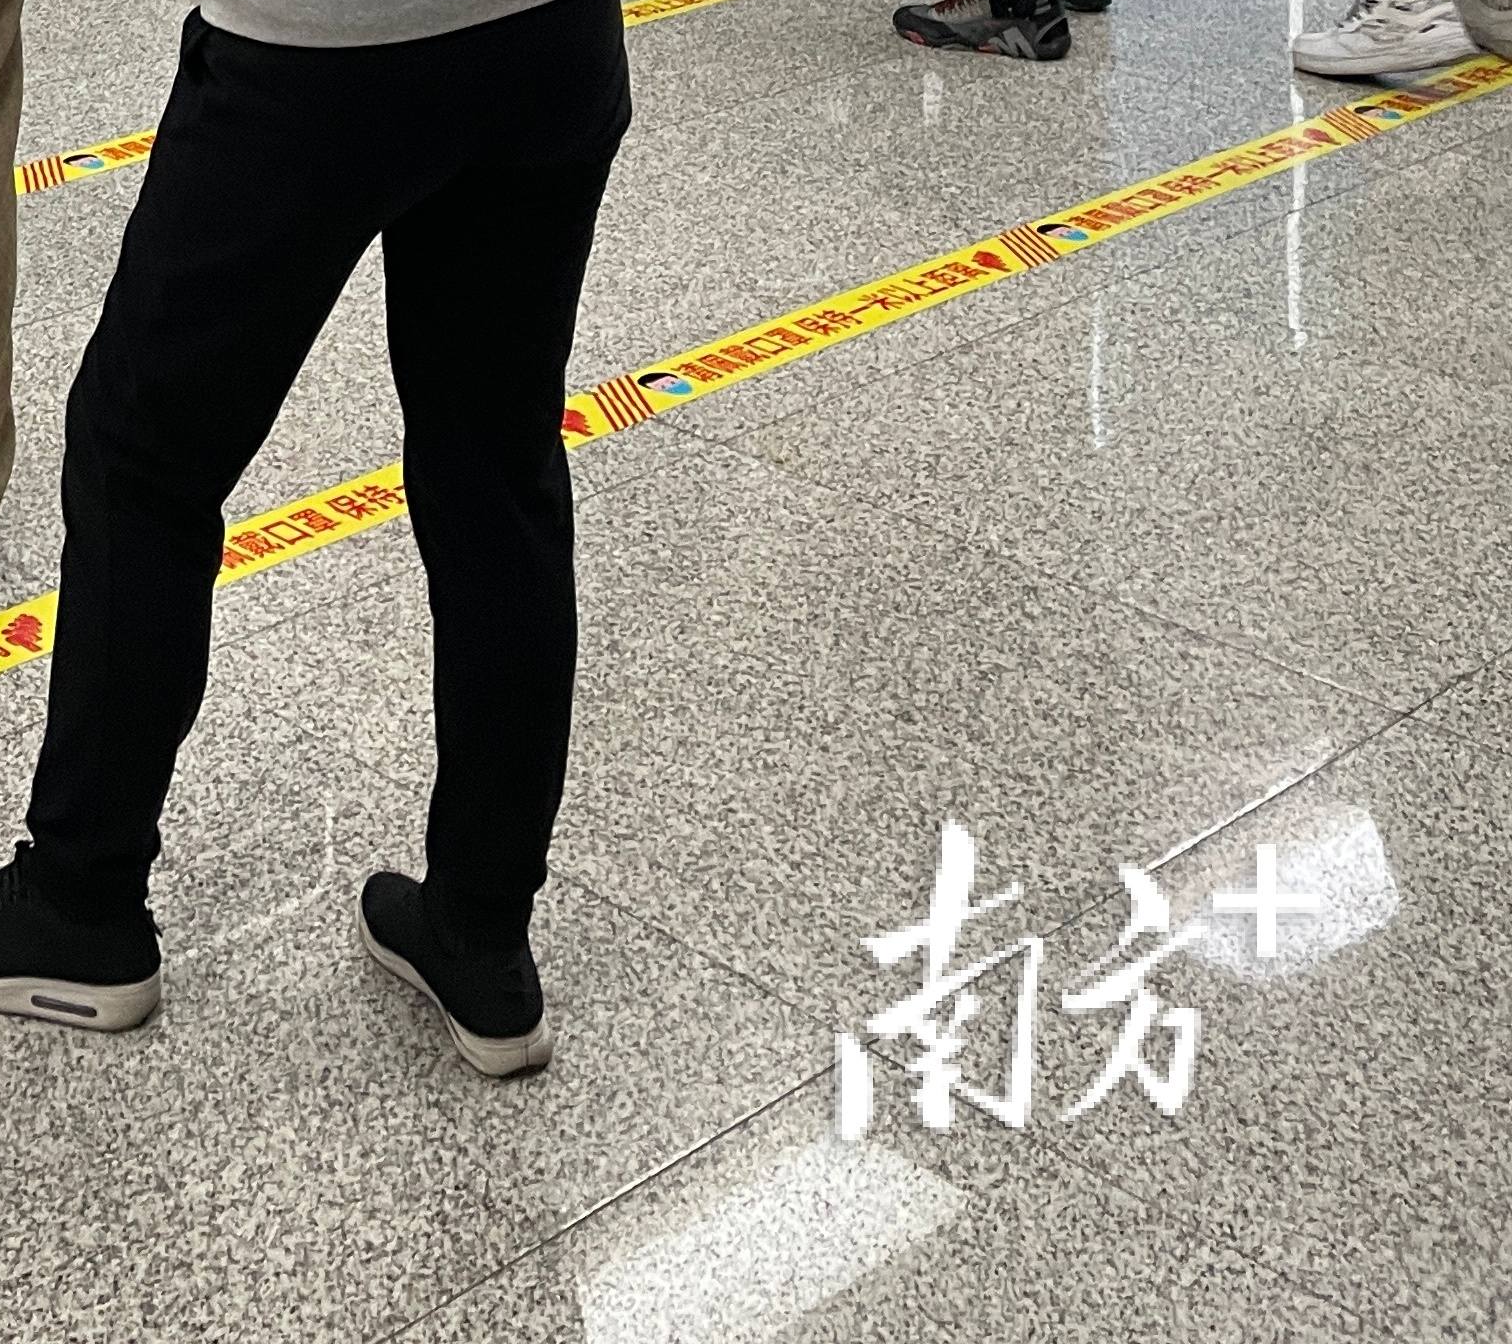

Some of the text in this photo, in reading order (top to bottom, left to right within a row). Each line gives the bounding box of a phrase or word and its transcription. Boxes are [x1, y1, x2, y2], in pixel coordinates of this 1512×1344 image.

[671, 261, 990, 383] 请佩戴口罩 保持一米以上距离
